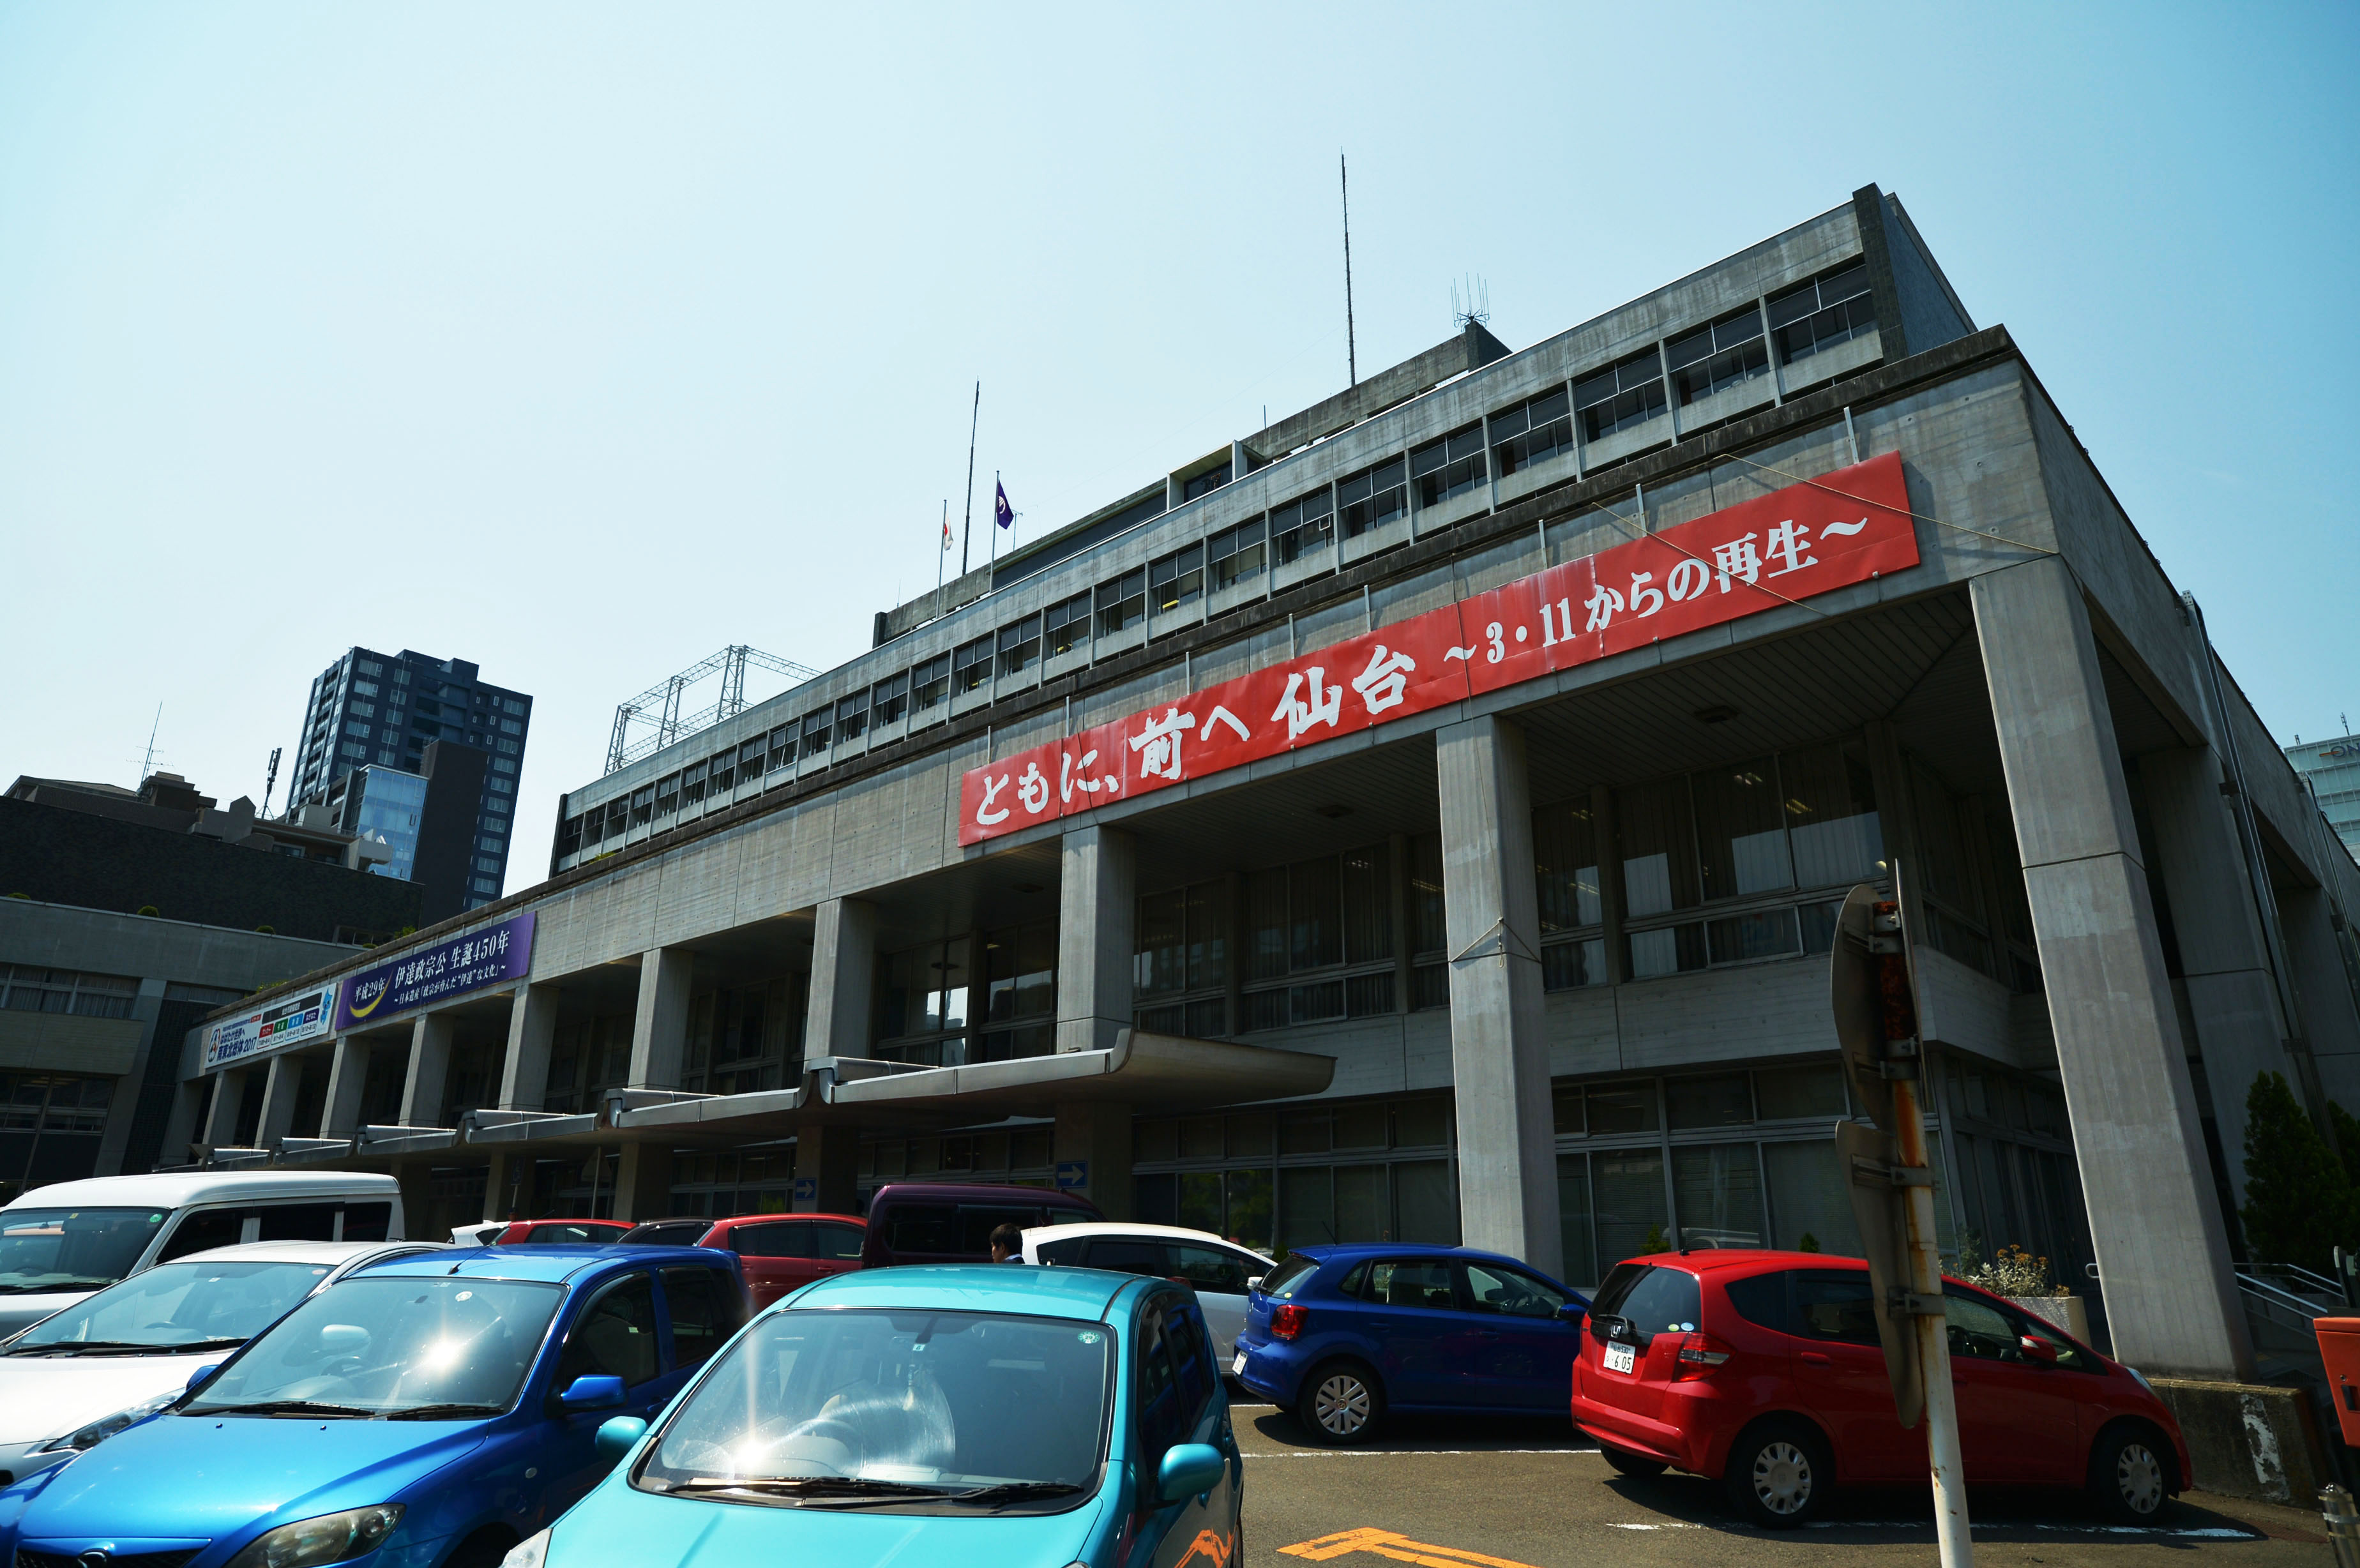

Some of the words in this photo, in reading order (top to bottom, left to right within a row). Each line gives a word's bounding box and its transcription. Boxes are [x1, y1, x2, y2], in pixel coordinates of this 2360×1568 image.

[1271, 644, 1416, 739] 仙台
[354, 977, 386, 1003] 平成29年
[395, 951, 446, 990] 伊達政宗公
[449, 930, 510, 970] 生誕450年
